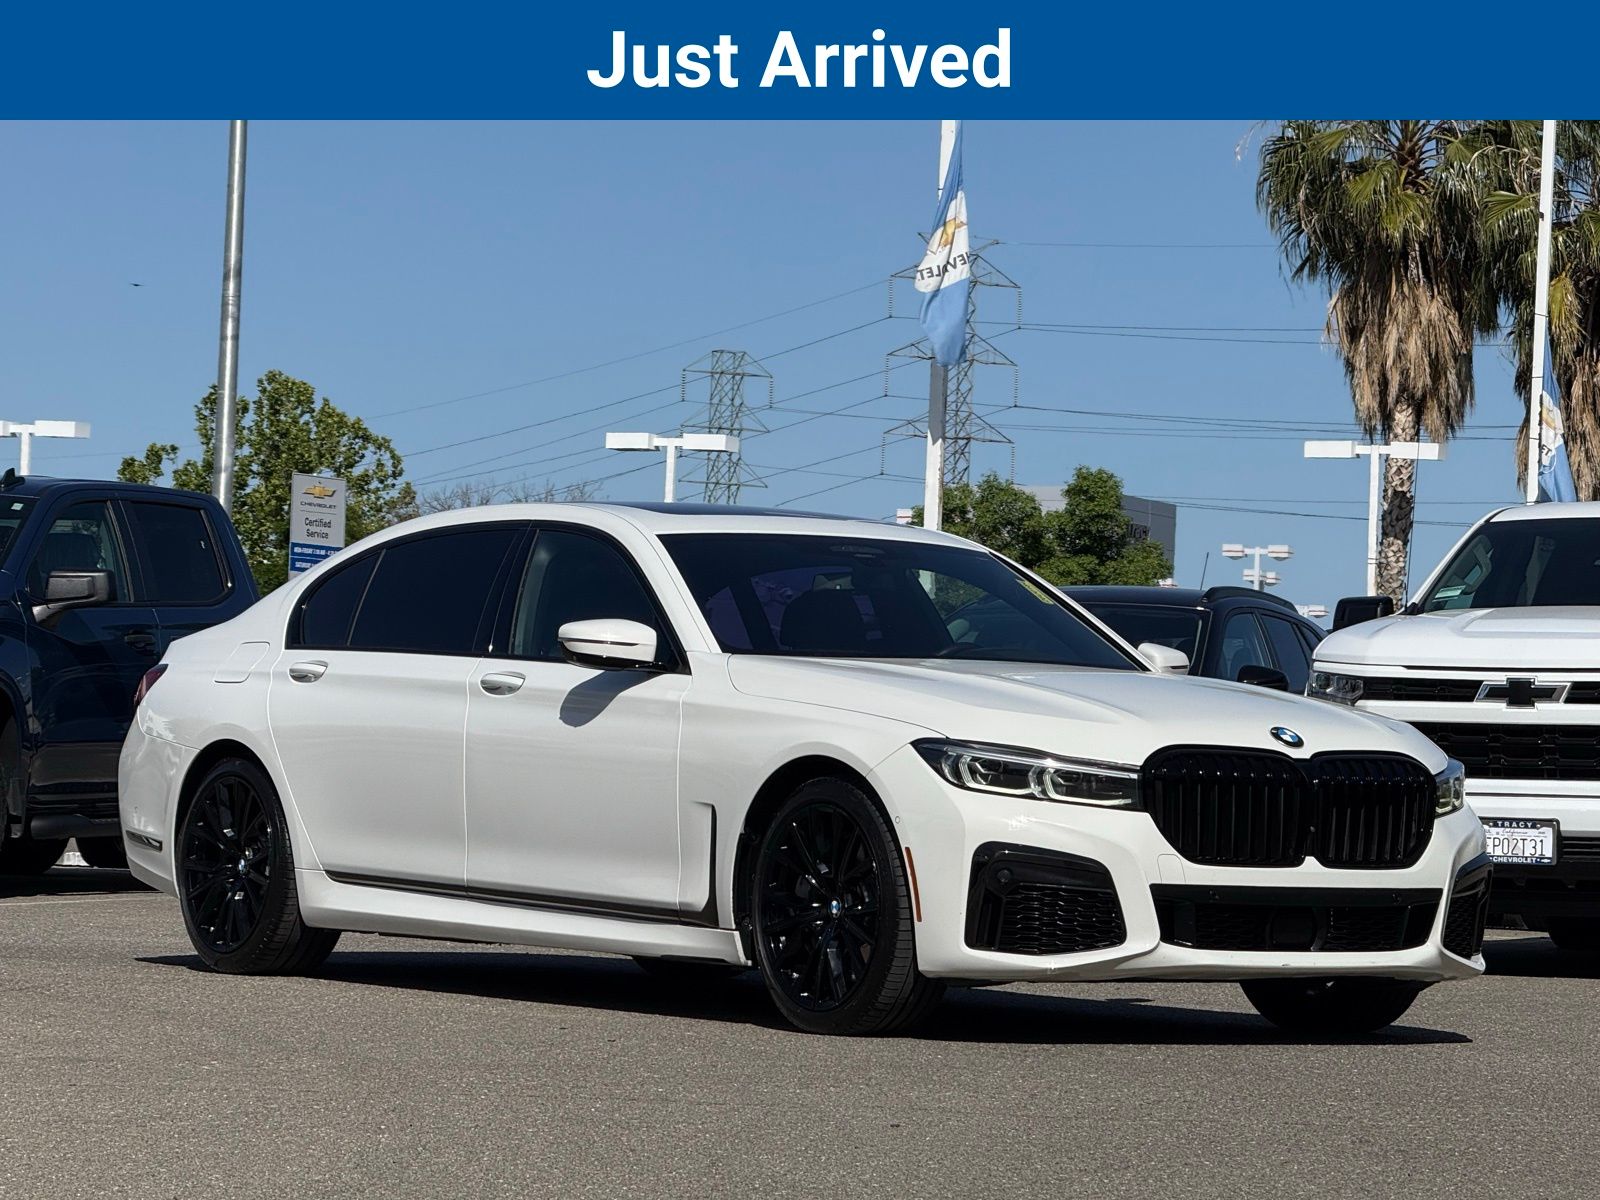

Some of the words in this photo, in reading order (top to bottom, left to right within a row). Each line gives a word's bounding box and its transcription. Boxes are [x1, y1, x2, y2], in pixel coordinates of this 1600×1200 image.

[300, 501, 336, 509] CHEVROLET
[304, 517, 331, 528] Certified
[306, 529, 329, 539] Service
